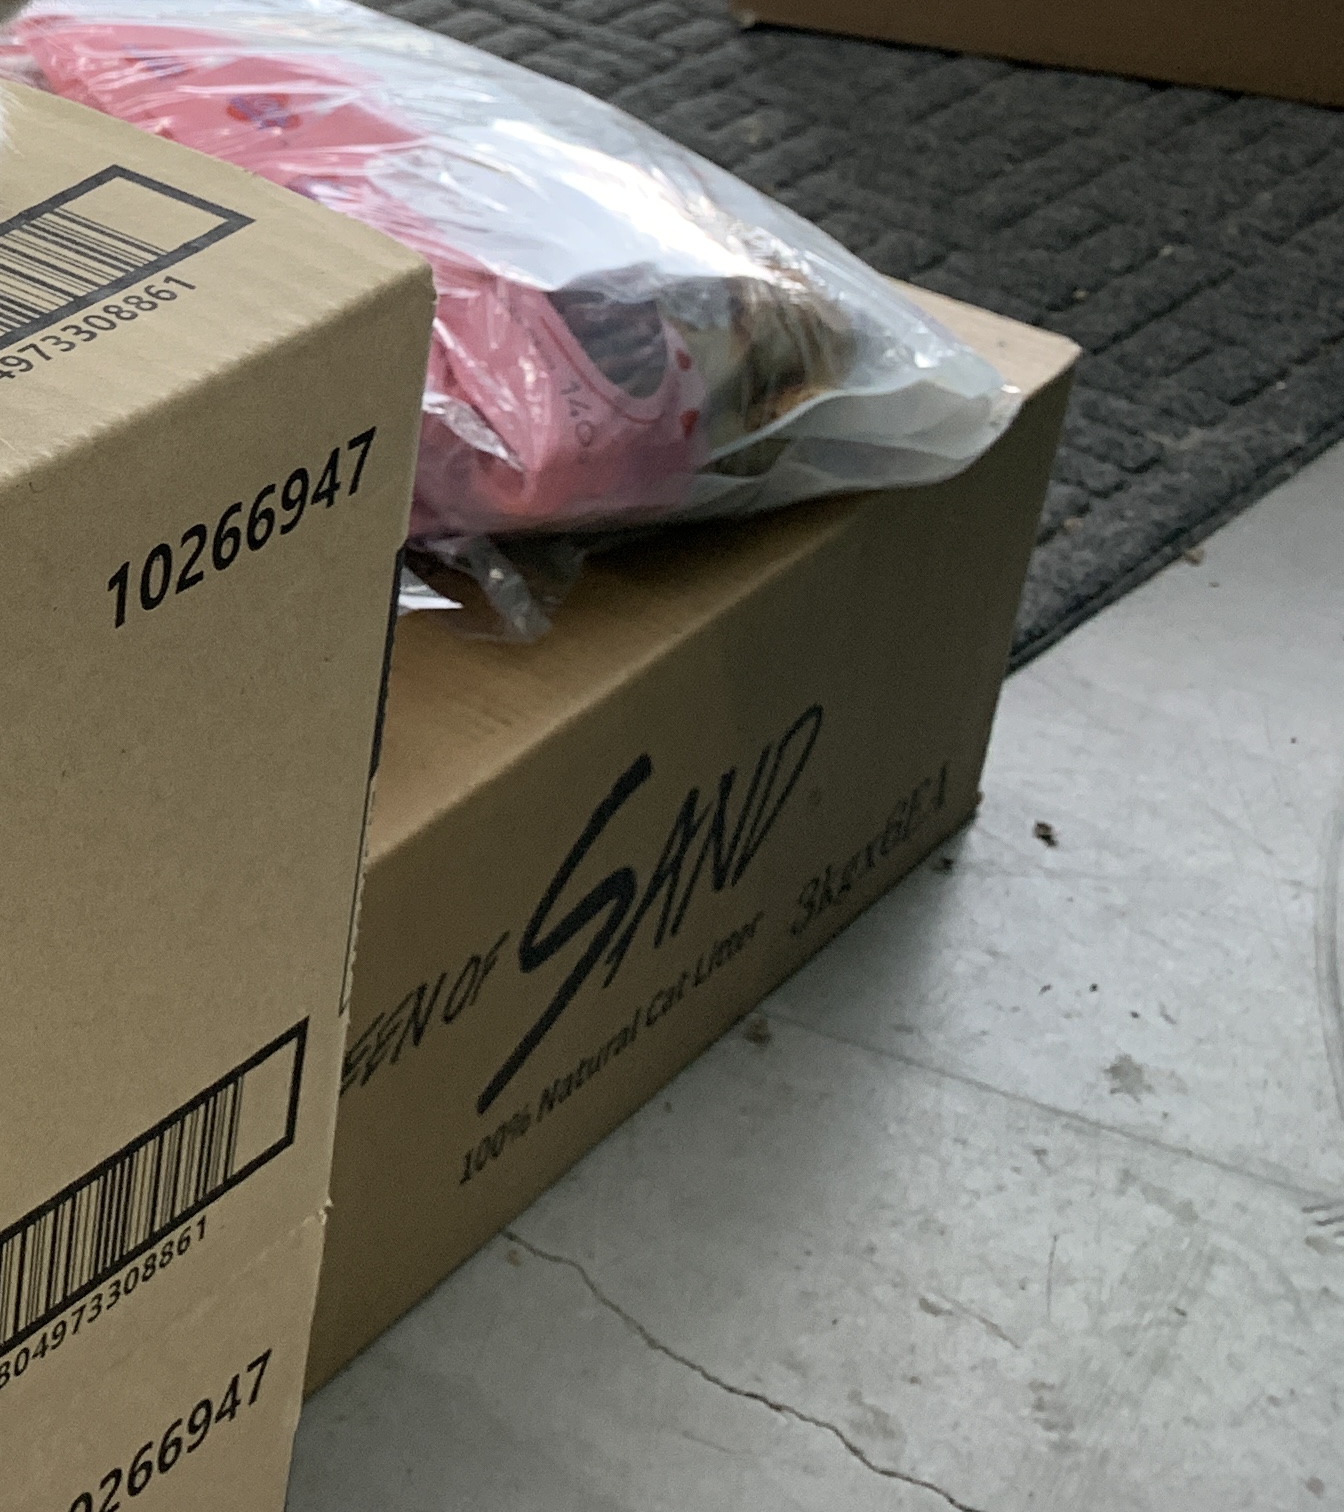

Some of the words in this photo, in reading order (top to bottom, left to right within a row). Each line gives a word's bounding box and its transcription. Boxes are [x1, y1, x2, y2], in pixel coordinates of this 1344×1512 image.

[107, 426, 378, 629] 10266947
[477, 704, 823, 1115] SAND
[537, 1006, 641, 1122] Natural
[645, 970, 690, 1027] Cat
